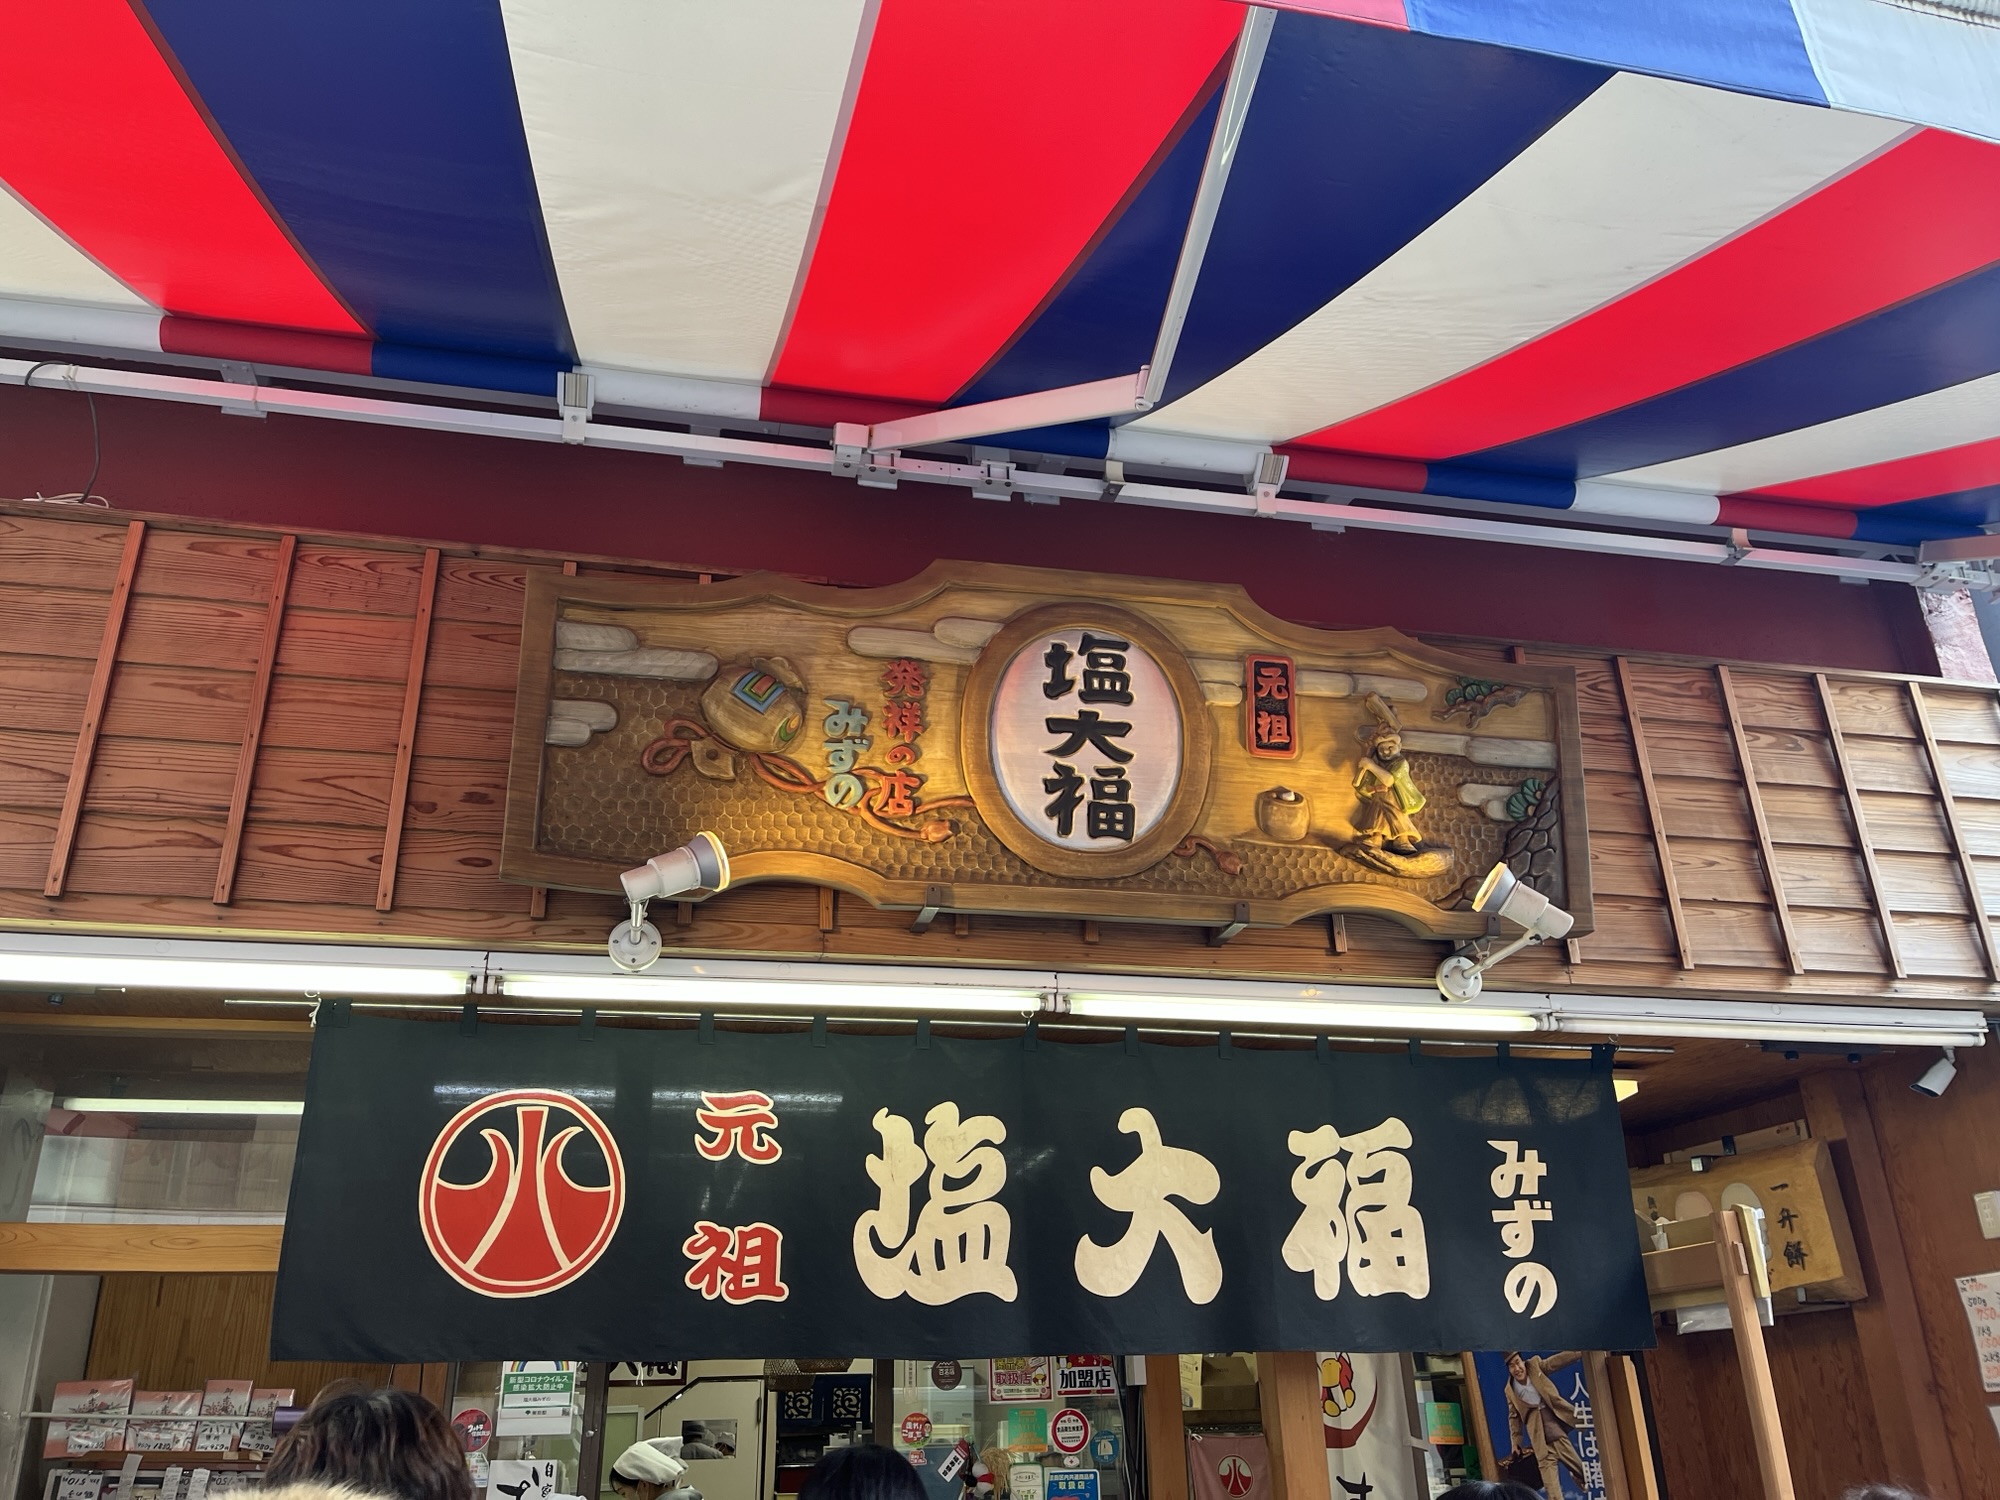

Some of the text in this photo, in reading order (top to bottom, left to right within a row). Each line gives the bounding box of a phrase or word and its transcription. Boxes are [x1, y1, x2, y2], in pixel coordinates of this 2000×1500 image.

[823, 698, 870, 810] みずの
[880, 658, 926, 816] 発祥の店
[1043, 632, 1135, 841] 塩大福
[1256, 667, 1290, 743] 元祖
[682, 1090, 789, 1305] 元祖
[853, 1101, 1430, 1306] 塩大福
[1487, 1140, 1558, 1319] みずの
[509, 1375, 569, 1384] 新型コロナウイルス
[512, 1383, 565, 1391] 感染拡大防止中
[1059, 1369, 1111, 1389] 加盟店
